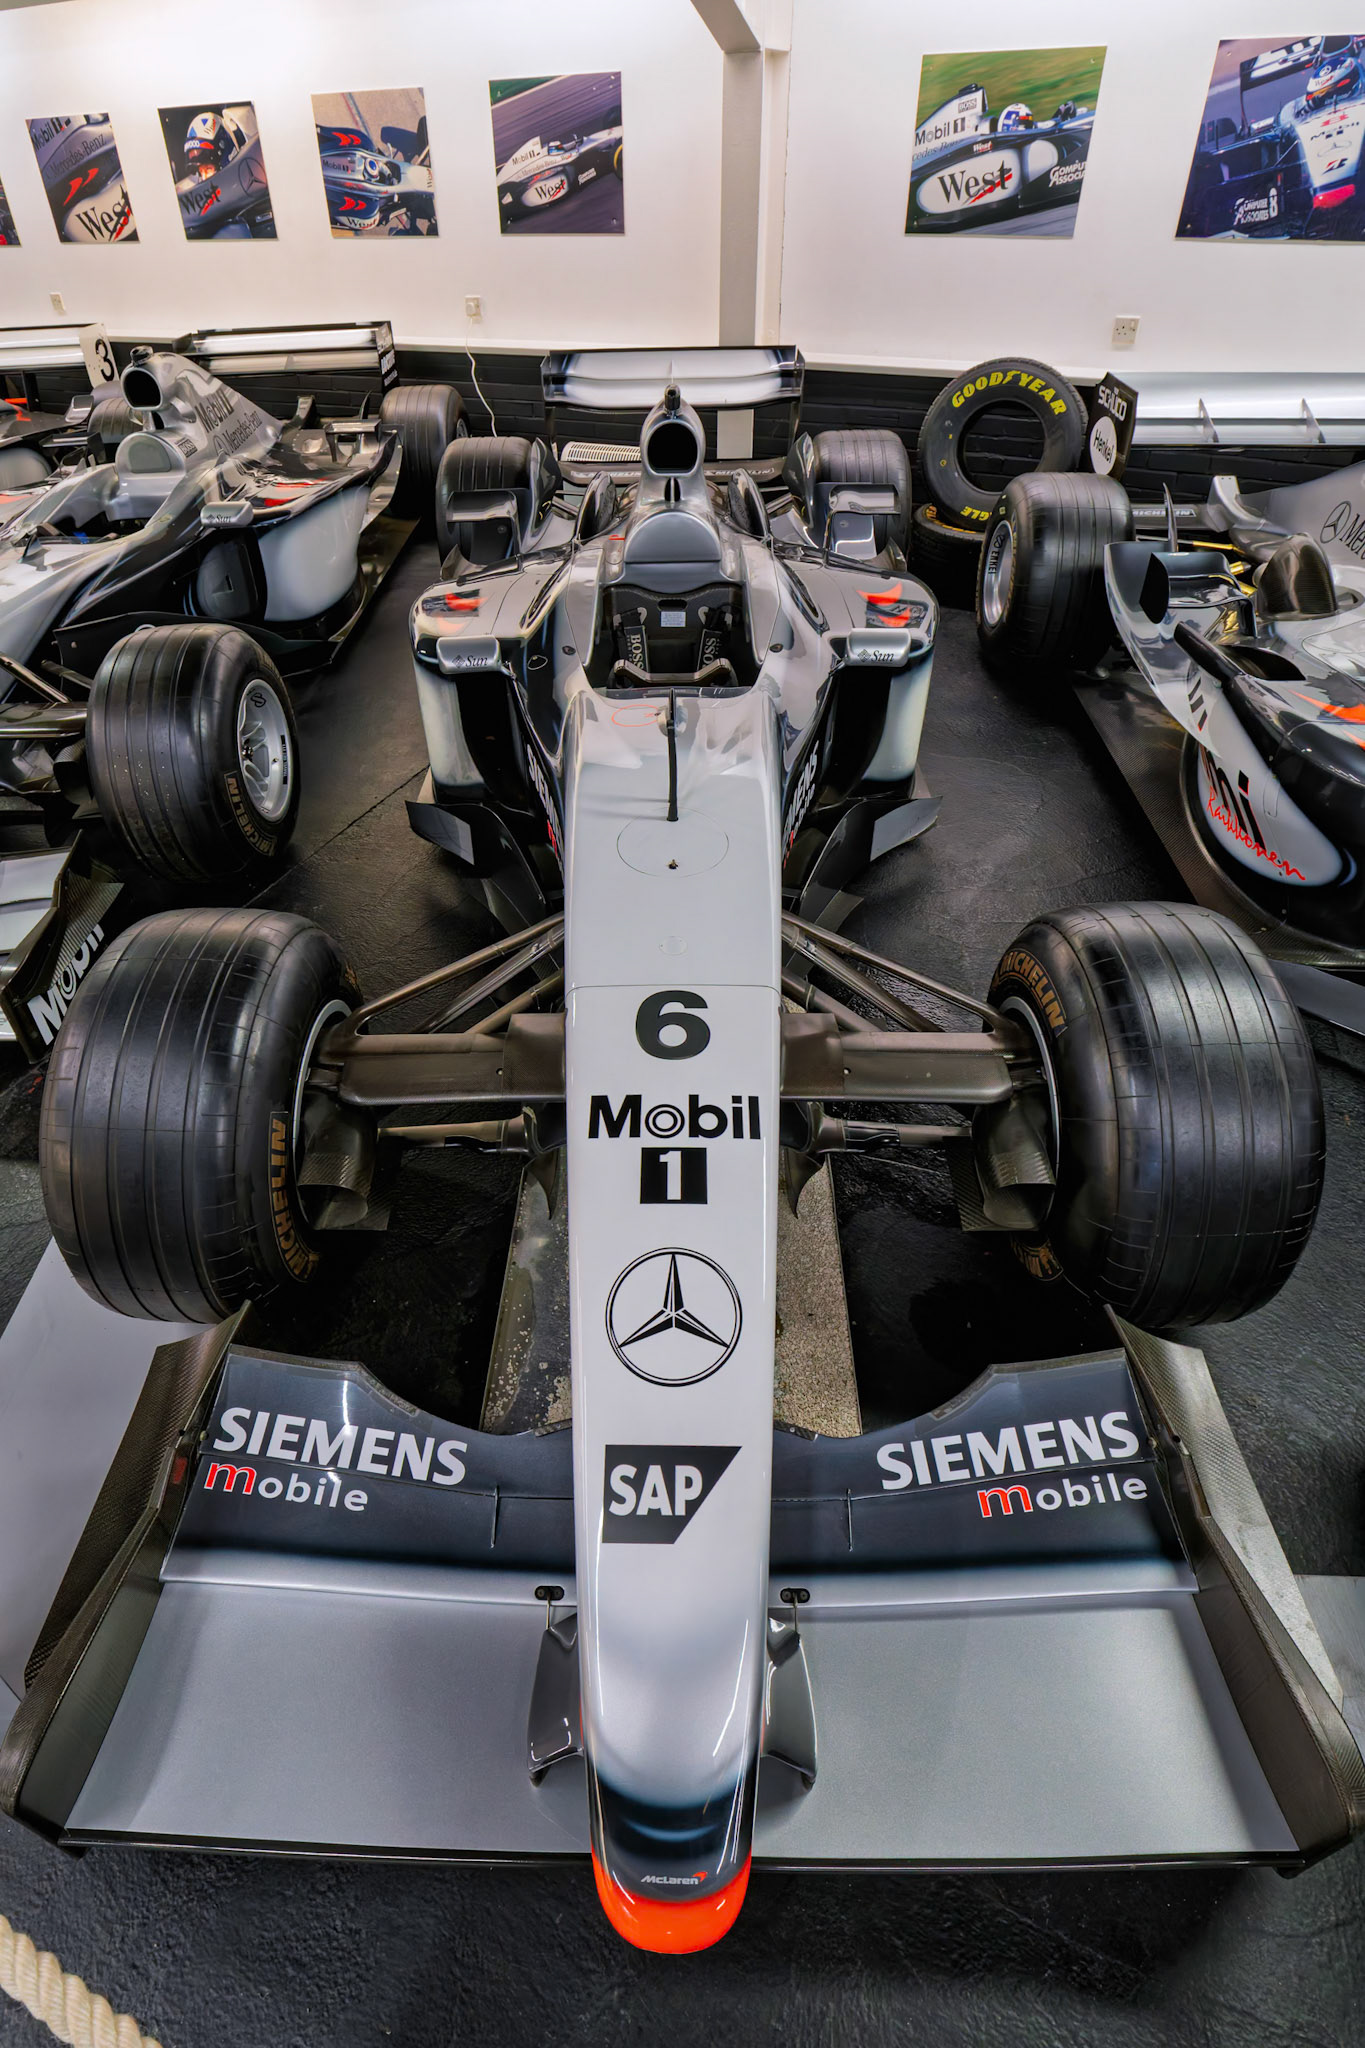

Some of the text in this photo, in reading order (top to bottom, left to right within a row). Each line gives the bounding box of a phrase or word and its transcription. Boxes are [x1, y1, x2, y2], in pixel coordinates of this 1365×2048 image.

[915, 121, 950, 146] Mobil
[323, 160, 341, 170] Mobil
[937, 160, 1013, 204] West
[180, 181, 221, 215] West
[534, 177, 566, 200] West
[1269, 187, 1278, 218] 8
[95, 338, 114, 381] 3
[195, 393, 224, 433] Mobil
[952, 370, 1067, 415] GOODYEAR
[223, 410, 262, 456] Mercedes-Benz
[1094, 429, 1114, 463] Henkel
[960, 506, 992, 521] GLE
[465, 655, 488, 668] Sun
[630, 633, 644, 669] BOSS
[702, 637, 717, 669] OSS
[871, 650, 895, 662] Sun
[227, 777, 276, 854] MICHELIN
[1000, 952, 1065, 1028] MICHELIN
[635, 990, 711, 1061] 6
[588, 1094, 761, 1140] Mobil
[271, 1119, 308, 1276] MICHELIN
[212, 1406, 468, 1486] SIEMENS
[876, 1411, 1140, 1490] SIEMENS
[202, 1461, 369, 1512] mobile
[608, 1463, 703, 1516] SAP
[976, 1472, 1148, 1518] mobile
[640, 1874, 699, 1885] McLaren
